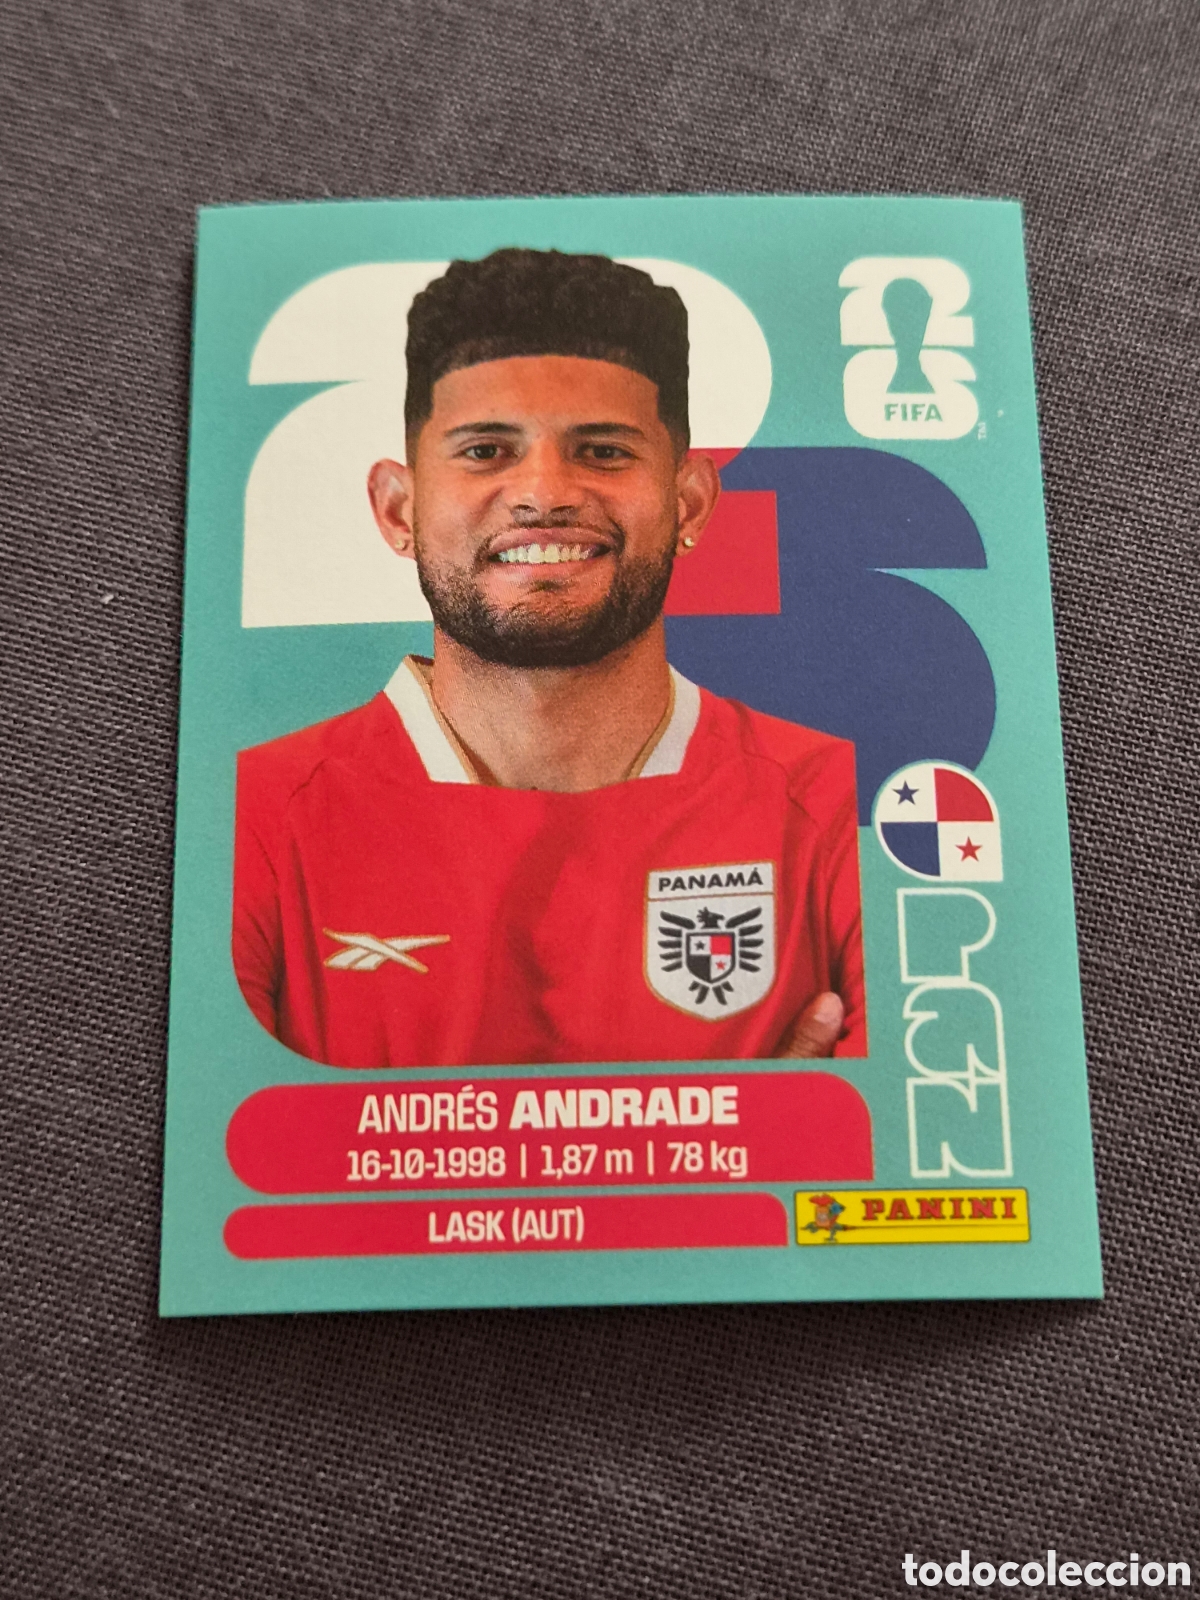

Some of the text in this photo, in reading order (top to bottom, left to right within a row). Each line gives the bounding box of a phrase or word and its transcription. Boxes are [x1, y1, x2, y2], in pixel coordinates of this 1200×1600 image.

[884, 403, 943, 422] FIFA
[658, 867, 763, 892] PANAMÁ
[357, 1084, 739, 1134] ANDRÉS ANDRADE
[346, 1145, 506, 1181] 16-10-1998
[541, 1144, 598, 1180] 1,87
[605, 1148, 633, 1174] m
[667, 1142, 703, 1173] 78
[711, 1141, 748, 1178] kg
[428, 1206, 584, 1243] LASK (AUT)
[861, 1197, 1017, 1221] PANINI
